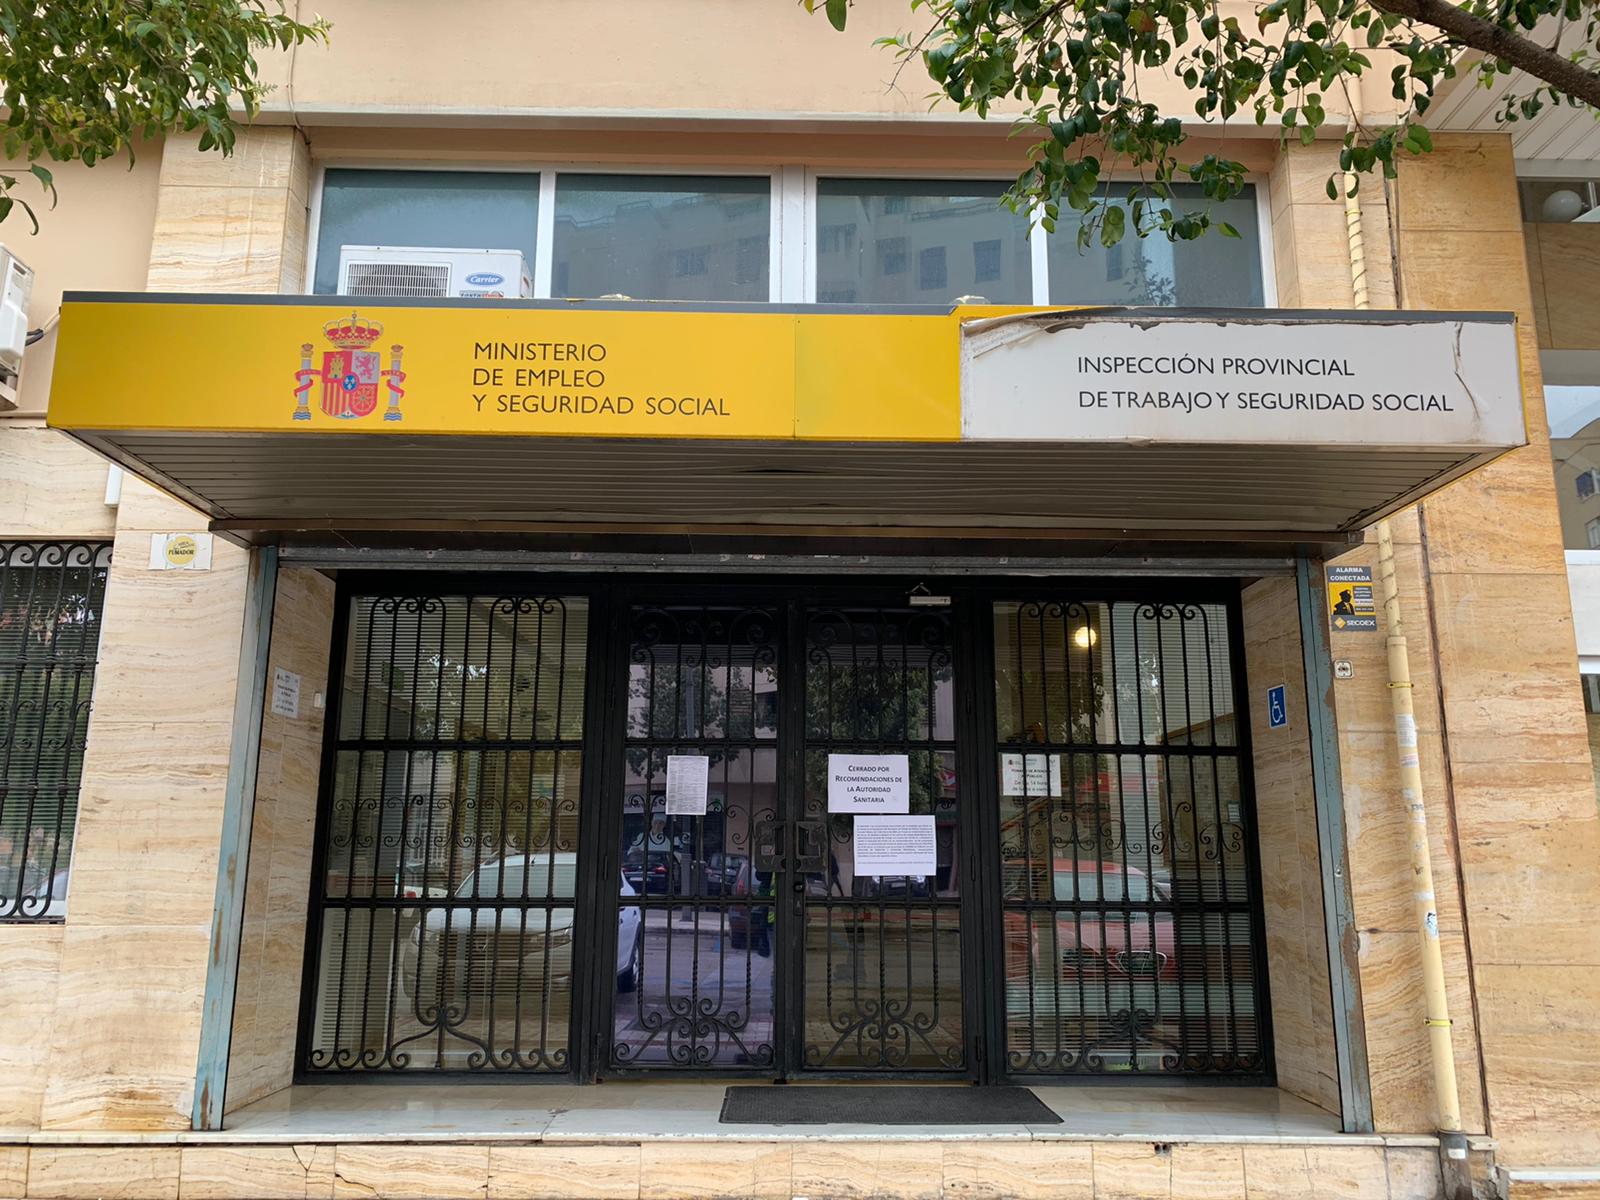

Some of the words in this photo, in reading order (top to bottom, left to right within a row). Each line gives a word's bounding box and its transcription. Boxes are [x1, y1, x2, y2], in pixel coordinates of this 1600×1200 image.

[474, 342, 606, 362] MINISTERIO
[1078, 353, 1214, 374] INSPECCIÓN
[1222, 358, 1355, 376] PROVINCIAL
[473, 368, 503, 386] DE
[515, 369, 605, 388] EMPLEO
[472, 394, 487, 412] Y
[496, 395, 634, 414] SEGURIDAD
[646, 397, 730, 416] SOCIAL
[1079, 391, 1108, 408] DE
[1112, 391, 1212, 413] TRABAJO
[1216, 392, 1230, 409] Y
[1237, 392, 1364, 410] SEGURIDAD
[1372, 394, 1454, 411] SOCIAL
